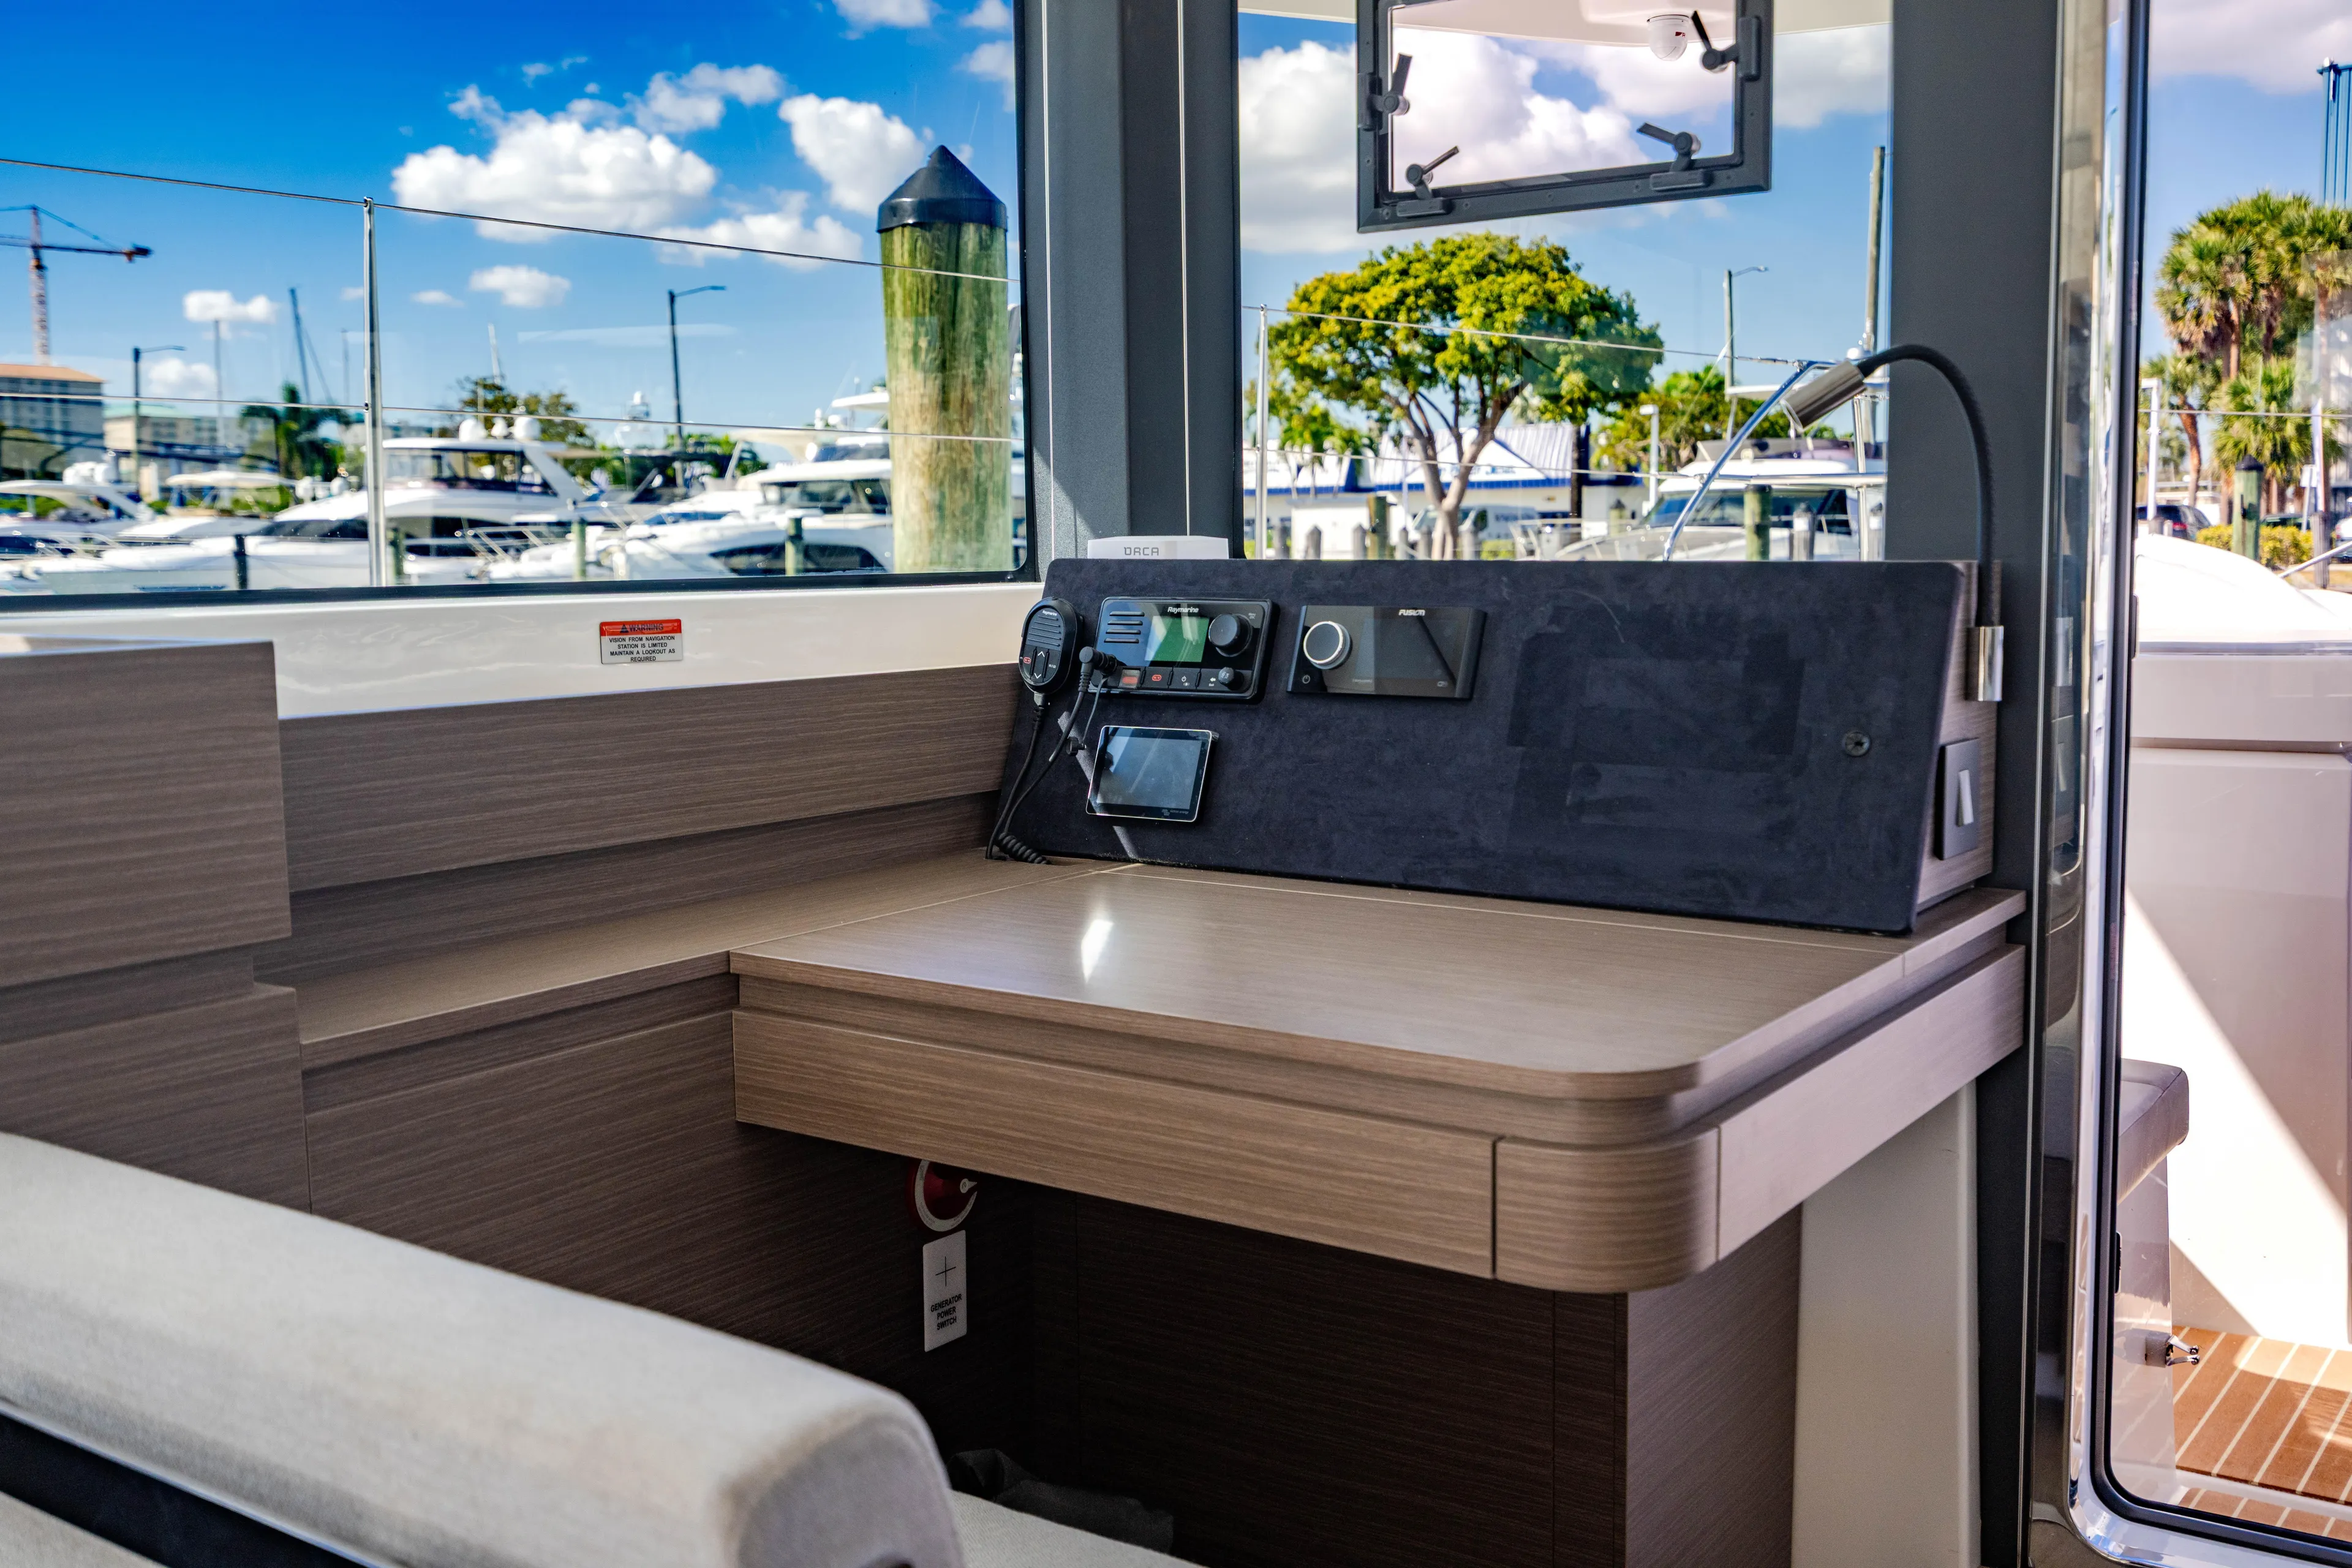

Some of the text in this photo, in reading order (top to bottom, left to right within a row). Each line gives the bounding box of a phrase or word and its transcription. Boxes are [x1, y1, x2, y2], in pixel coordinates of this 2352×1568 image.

[1123, 547, 1159, 556] ORCA
[628, 624, 664, 632] WARNING
[930, 1294, 962, 1313] GENERATOR
[937, 1307, 956, 1320] POWER
[937, 1317, 956, 1330] SWITCH
